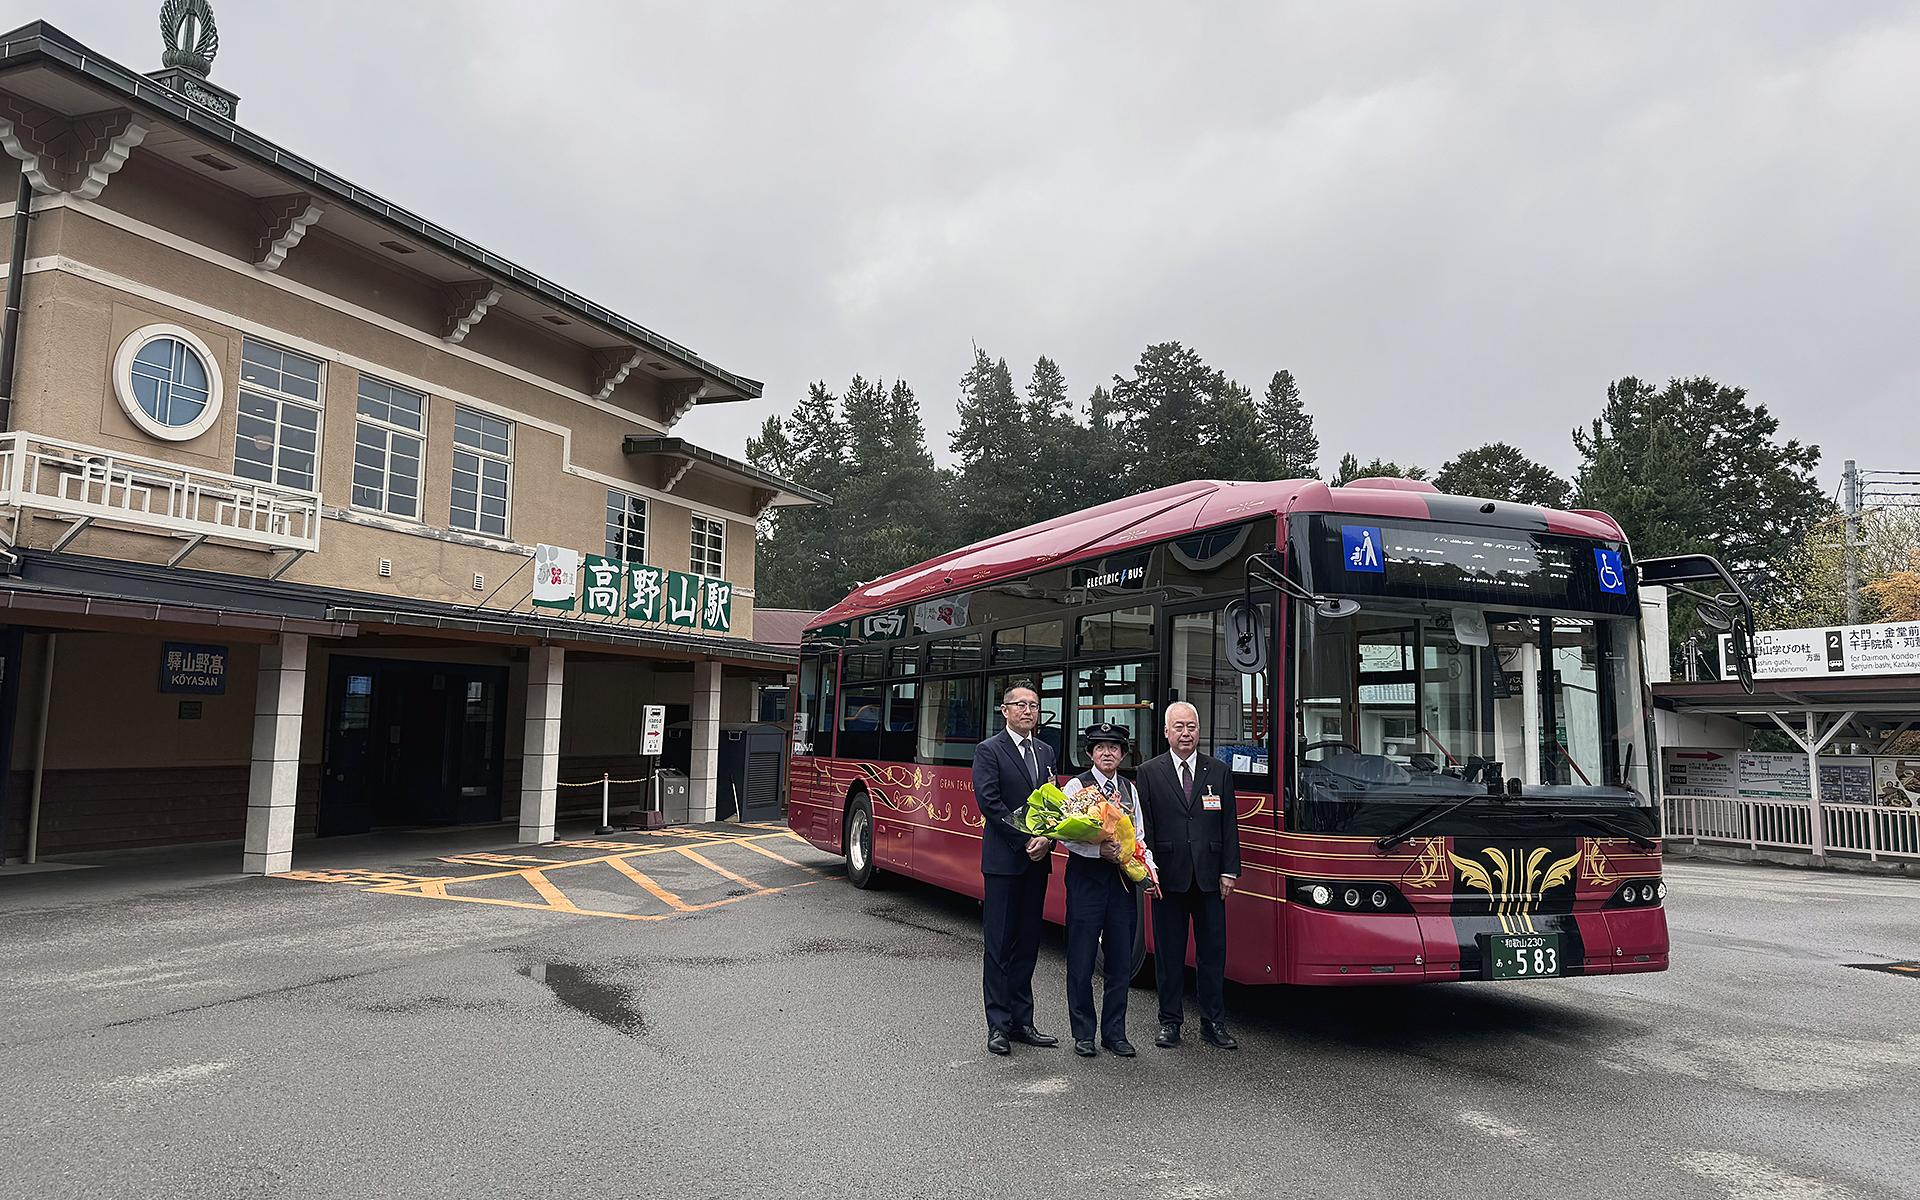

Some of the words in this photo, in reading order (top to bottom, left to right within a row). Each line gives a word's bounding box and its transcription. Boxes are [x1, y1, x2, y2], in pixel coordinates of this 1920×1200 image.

[1086, 571, 1119, 588] ELECTRIC
[1128, 566, 1143, 580] BUS
[587, 558, 730, 628] 高野山駅
[1828, 636, 1839, 648] 2
[1850, 654, 1860, 662] for
[1861, 653, 1890, 661] Daimon,
